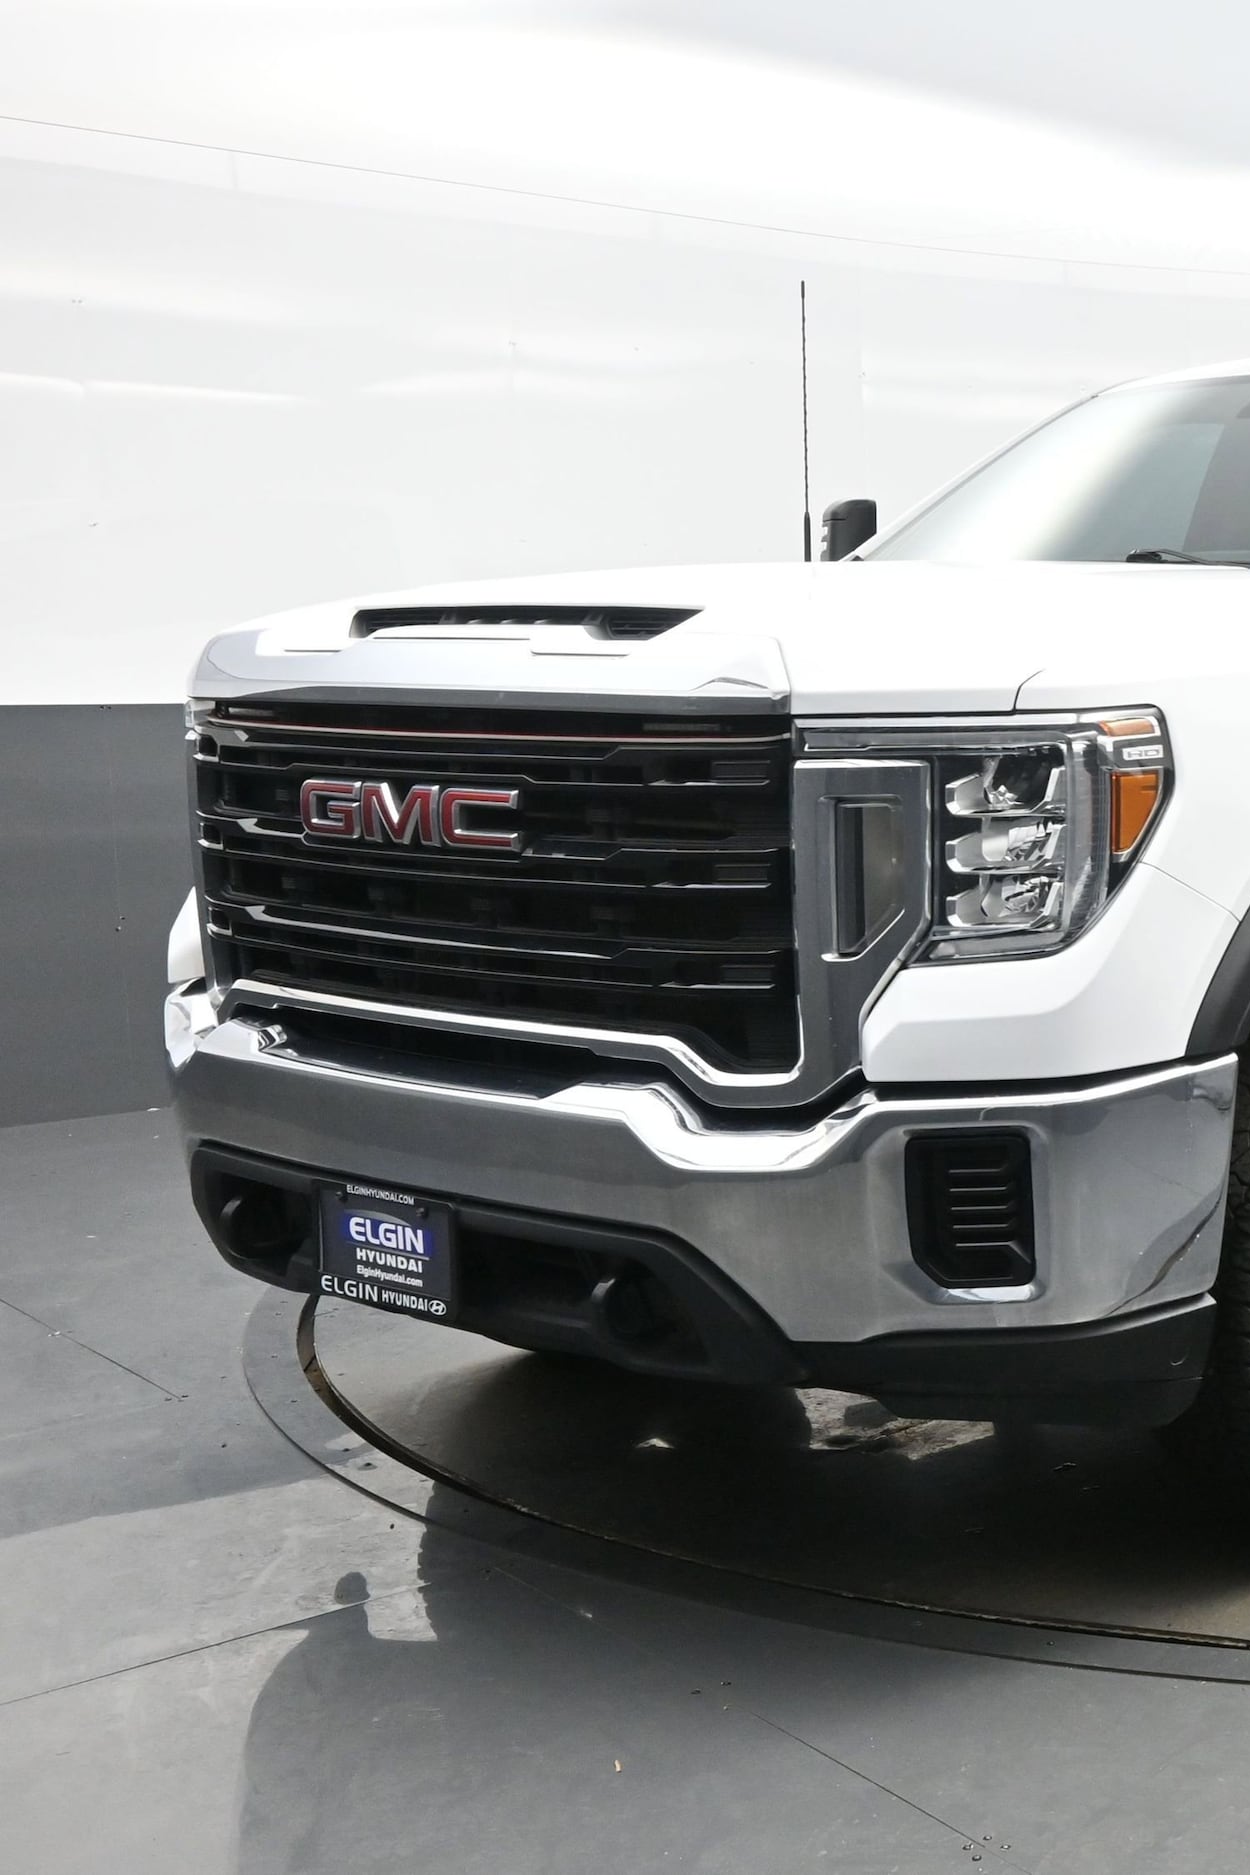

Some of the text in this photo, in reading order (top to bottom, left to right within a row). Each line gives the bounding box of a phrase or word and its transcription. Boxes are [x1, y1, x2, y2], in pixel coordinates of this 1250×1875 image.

[1127, 747, 1161, 759] HD
[300, 778, 520, 852] GMC
[346, 1184, 415, 1206] ELGINHYUNDAI.COM
[349, 1216, 425, 1254] ELGIN
[356, 1247, 423, 1274] HYUNDAI
[356, 1264, 423, 1288] ElginHyundai.com
[320, 1274, 428, 1312] ELGIN HYUNDAI
